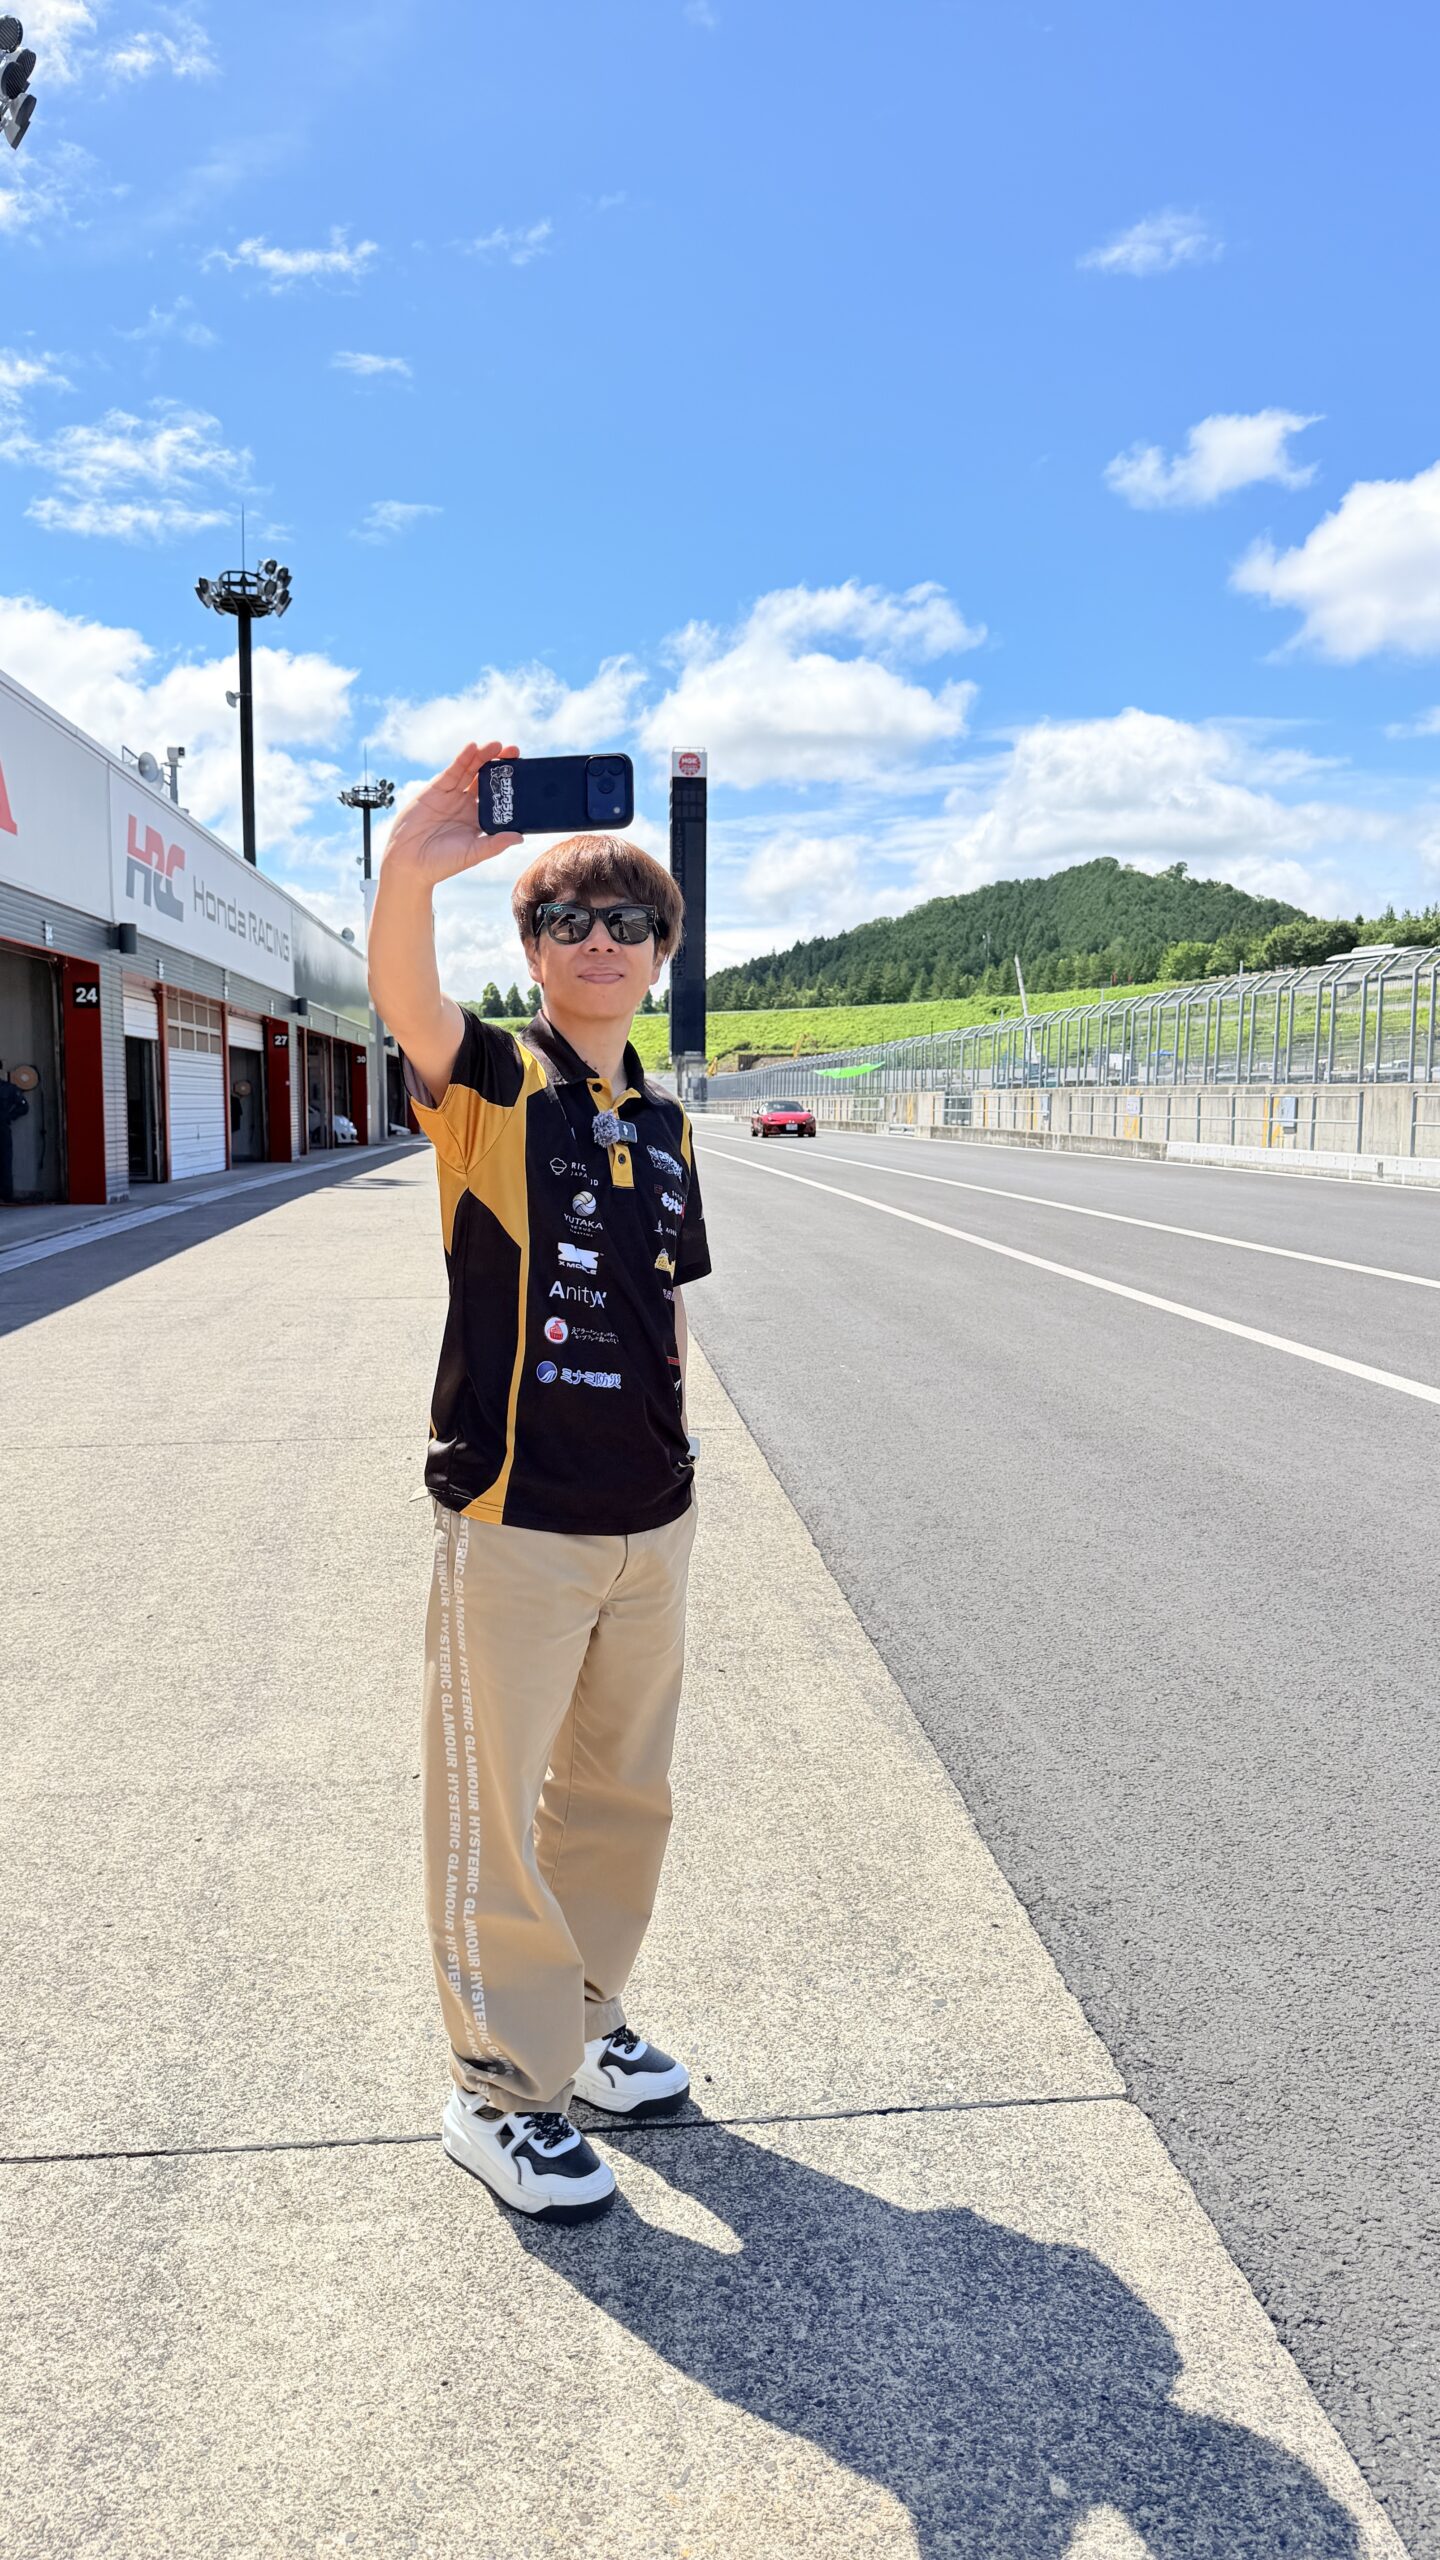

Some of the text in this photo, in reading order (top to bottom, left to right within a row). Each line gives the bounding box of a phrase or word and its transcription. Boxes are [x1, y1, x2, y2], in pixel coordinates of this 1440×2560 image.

[193, 875, 290, 963] Honda RACING
[75, 987, 98, 1004] 24
[274, 1035, 288, 1047] 27
[356, 1055, 367, 1064] 30
[563, 1213, 604, 1231] YUTAKA
[560, 1368, 622, 1389] ミナミ防災
[436, 1532, 450, 1607] GLAMOUR
[440, 1612, 453, 1690] HYSTERIC
[454, 1578, 467, 1653] GLAMOUR
[441, 1693, 457, 1769] GLAMOUR
[459, 1655, 474, 1732] HYSTERIC
[464, 1735, 480, 1811] GLAMOUR
[447, 1773, 461, 1850] HYSTERIC
[466, 1815, 481, 1894] HYSTERIC
[444, 1853, 460, 1932] GLAMOUR
[463, 1897, 481, 1968] GLAMOUR
[470, 1971, 492, 2046] HYSTERIC
